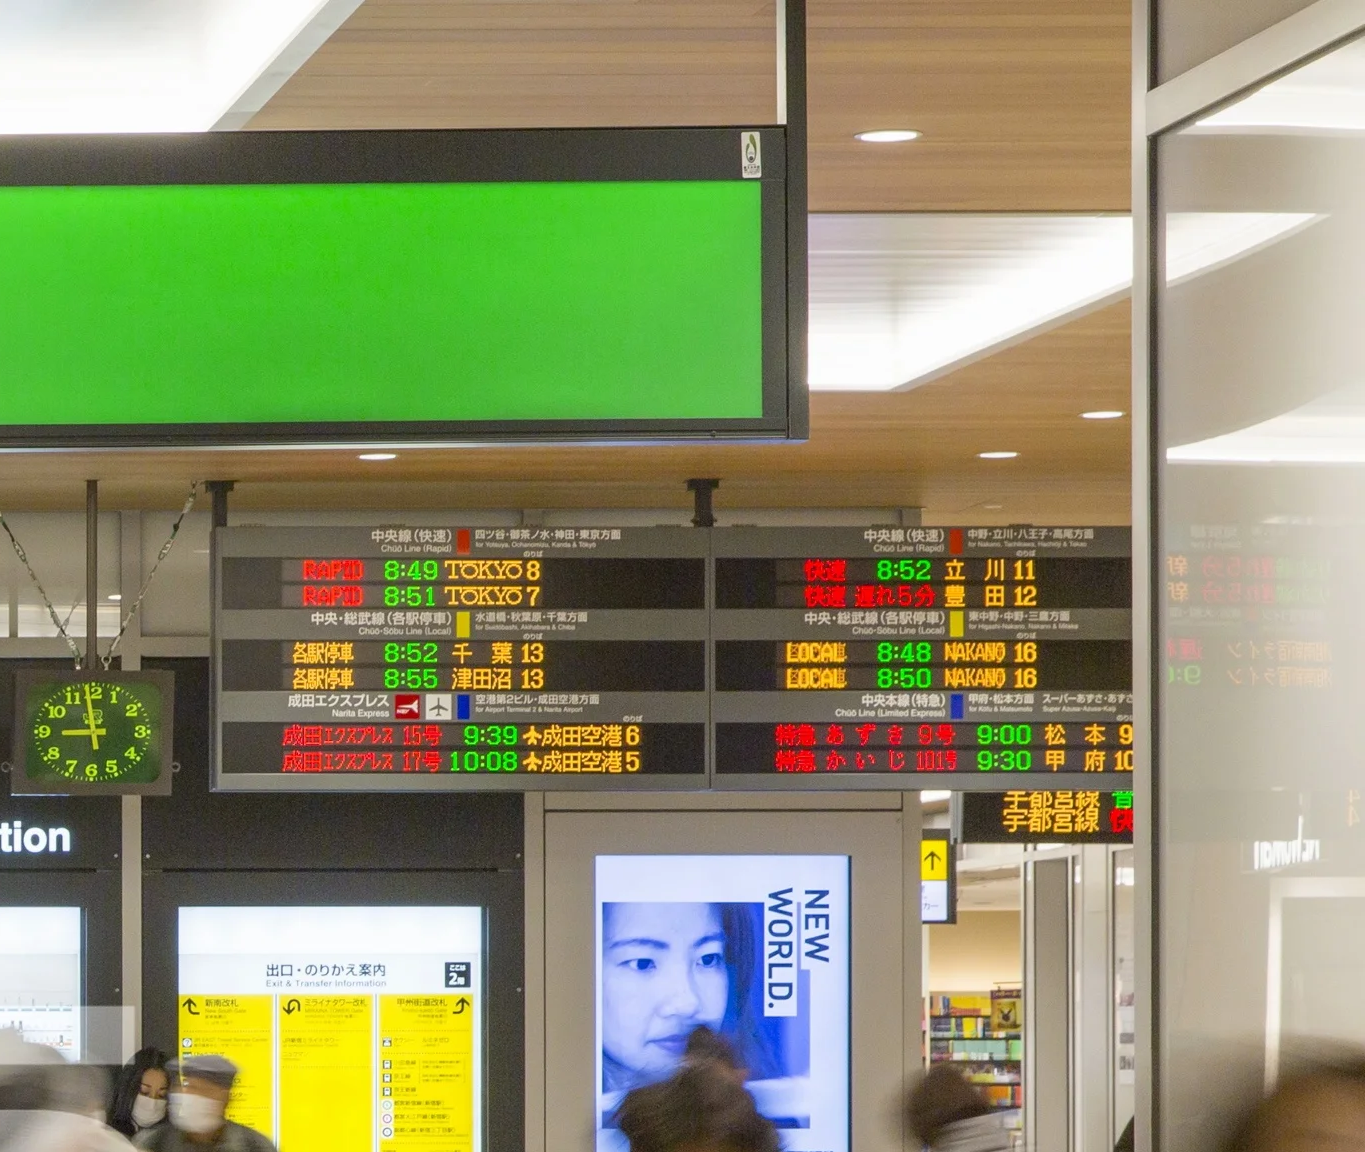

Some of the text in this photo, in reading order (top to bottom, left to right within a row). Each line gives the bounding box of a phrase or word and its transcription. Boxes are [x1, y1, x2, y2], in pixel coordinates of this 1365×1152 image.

[303, 560, 541, 580] RAPID 8:49 8
[877, 560, 1035, 580] 8:52 11
[303, 586, 540, 606] RAPID 8:51 7
[1014, 586, 1037, 606] 12
[385, 643, 544, 663] 8:52 13
[877, 643, 1037, 662] 8:48 16
[385, 668, 544, 690] 8:55 津田沼 13
[877, 668, 1037, 688] 8:50 16
[288, 694, 389, 707] 成田エクスプレス
[49, 706, 66, 718] 10
[39, 726, 51, 738] 9
[134, 726, 147, 738] 3
[464, 726, 640, 746] 9:39 6
[977, 725, 1031, 745] 9:00
[85, 764, 98, 777] 6
[450, 752, 640, 772] 10:08 5
[977, 751, 1031, 770] 9:30
[803, 889, 830, 963] NEW
[766, 887, 793, 1010] WORLD.
[266, 963, 386, 977] 出口・のりかえ案内
[205, 999, 238, 1007] 新南改札
